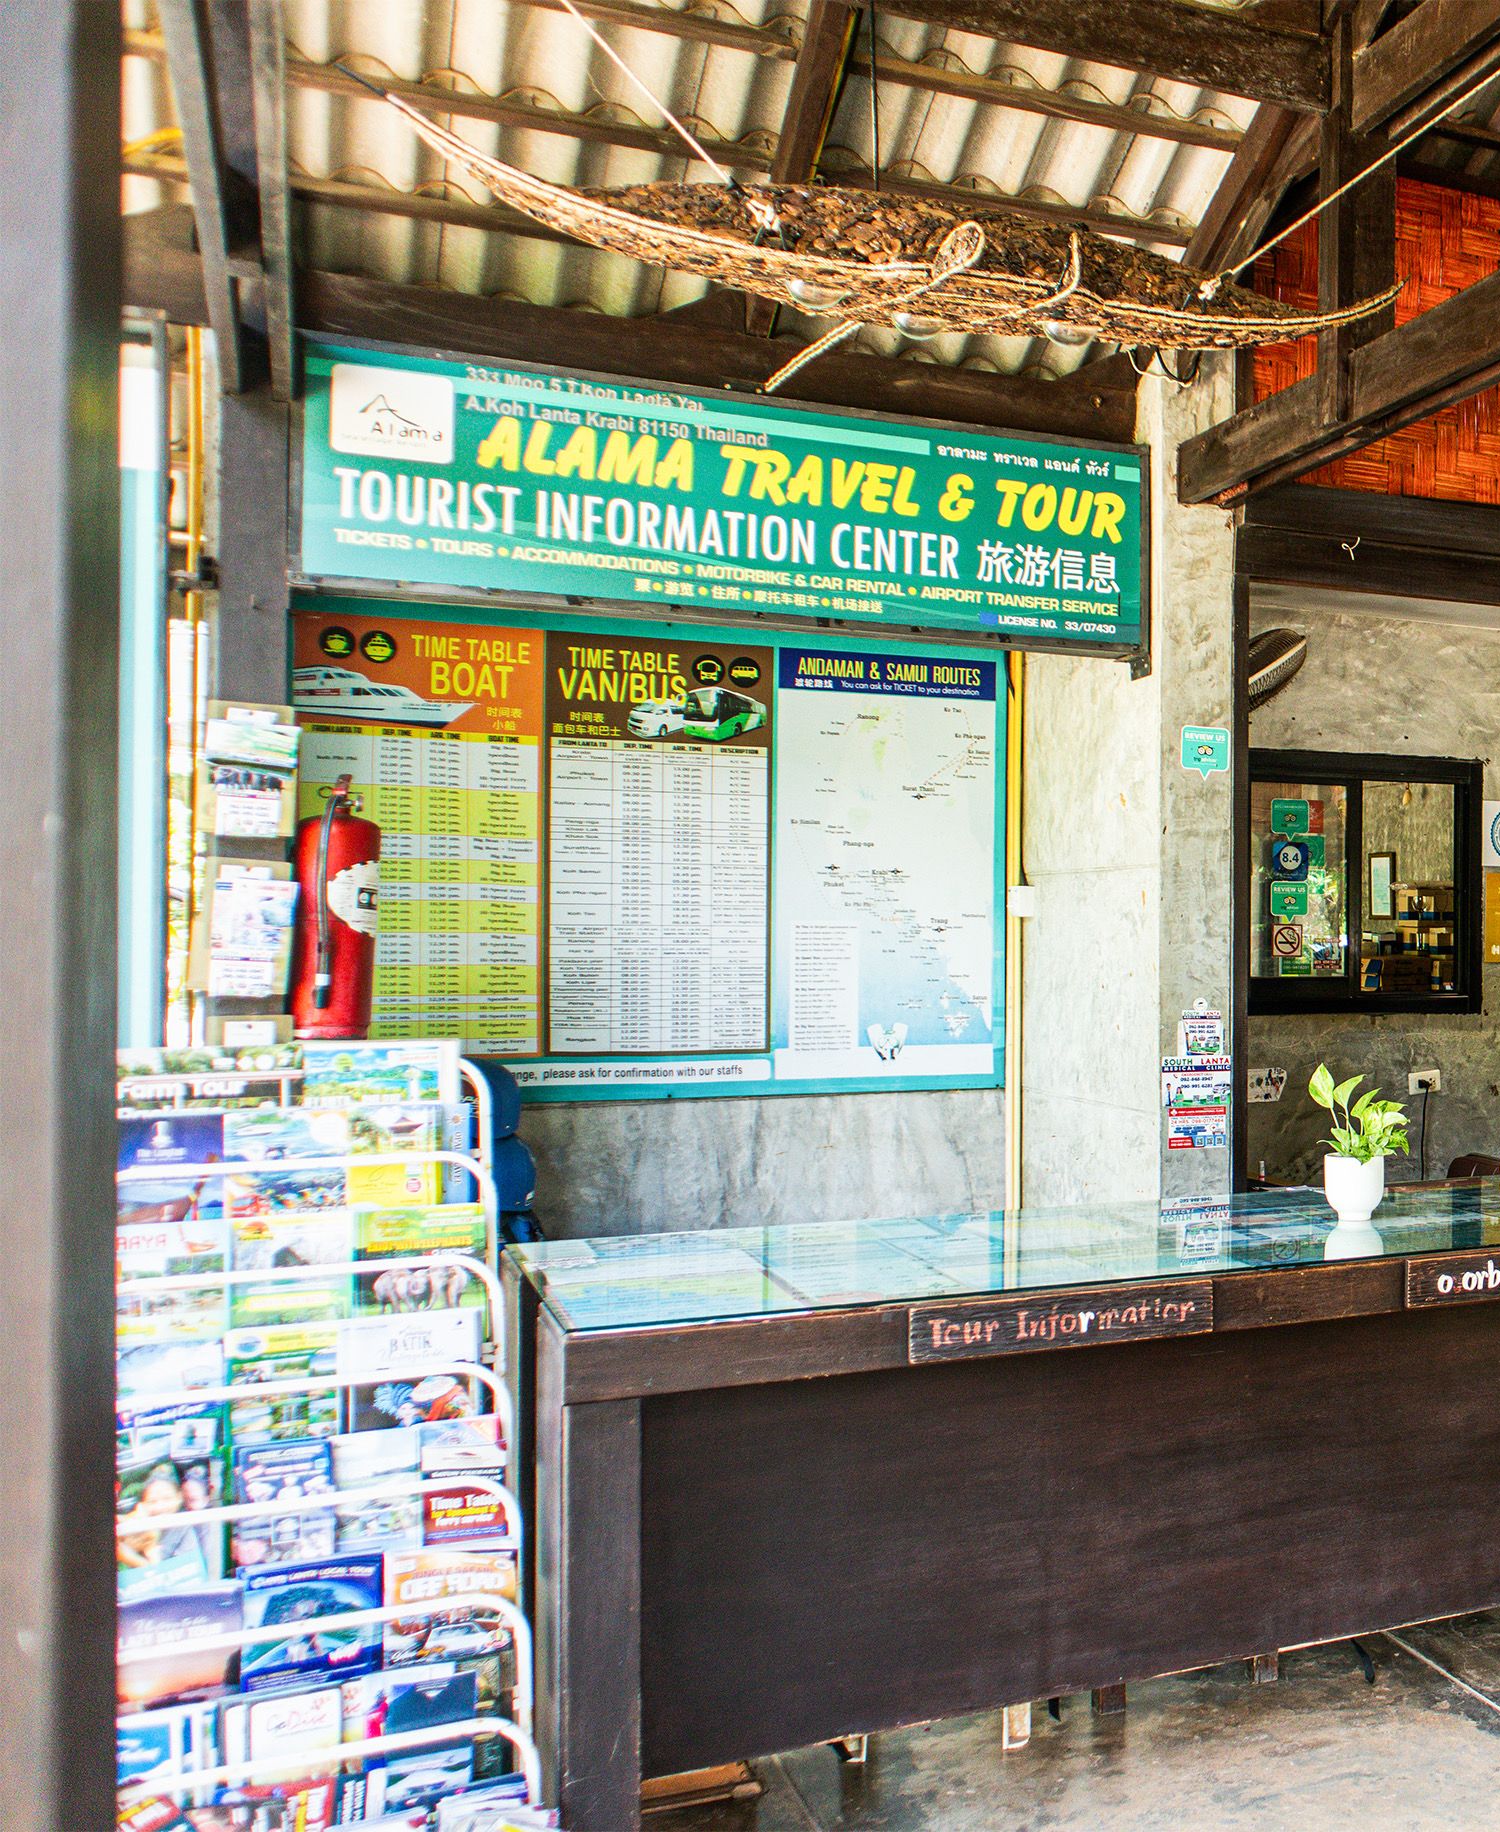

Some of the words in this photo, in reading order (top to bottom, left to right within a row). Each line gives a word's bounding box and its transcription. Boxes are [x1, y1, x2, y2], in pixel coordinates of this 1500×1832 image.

[466, 367, 499, 384] 333
[505, 373, 544, 391] Moo
[550, 378, 562, 392] 5
[370, 420, 443, 442] Alama
[465, 396, 525, 418] A.Koh
[530, 403, 581, 425] Lanta
[586, 411, 634, 433] Krabi
[639, 419, 690, 440] 81150
[694, 424, 768, 448] Thailand
[476, 415, 694, 493] ALAMA
[719, 443, 920, 518] TRAVEL
[937, 472, 976, 523] &
[994, 478, 1127, 545] TOUR
[333, 467, 523, 536] TOURIST
[535, 489, 817, 566] INFORMATION
[830, 522, 960, 581] CENTER
[976, 539, 1121, 595] 旅游信息
[333, 528, 413, 551] TICKETS
[430, 536, 494, 558] TOURS
[510, 546, 680, 576] ACCOMMODATIONS
[696, 564, 791, 588] MOTORBIKE
[794, 572, 808, 588] &
[808, 573, 844, 592] CAR
[845, 577, 906, 598] RENTAL
[920, 587, 984, 607] AIRPORT
[985, 592, 1060, 612] TRANSFER
[1061, 598, 1120, 617] SERVICE
[998, 614, 1038, 629] LICENSE
[1064, 620, 1117, 636] 33/07430
[411, 633, 461, 660] TIME
[465, 637, 531, 665] TABLE
[568, 646, 615, 670] TIME
[619, 649, 680, 674] TABLE
[430, 661, 514, 699] BOAT
[797, 656, 864, 679] ANDAMAN
[869, 661, 881, 680] &
[886, 662, 928, 683] SAMUI
[932, 665, 981, 687] ROUTES
[557, 667, 688, 706] VAN/BUS
[841, 679, 854, 689] You
[855, 682, 868, 690] can
[869, 681, 882, 691] ask
[883, 682, 893, 691] for
[894, 682, 917, 693] TICKET
[926, 687, 941, 696] your
[942, 685, 980, 697] destination
[1282, 853, 1299, 863] 8.4
[543, 1067, 576, 1082] please
[578, 1067, 596, 1079] ask
[597, 1067, 611, 1078] for
[614, 1065, 674, 1079] confirmation
[677, 1065, 697, 1077] with
[698, 1066, 715, 1077] our
[716, 1064, 744, 1076] staffs
[1164, 1058, 1193, 1066] SOUTH
[1200, 1057, 1230, 1065] LANTA
[190, 1078, 249, 1098] Tour
[430, 1495, 464, 1512] Time
